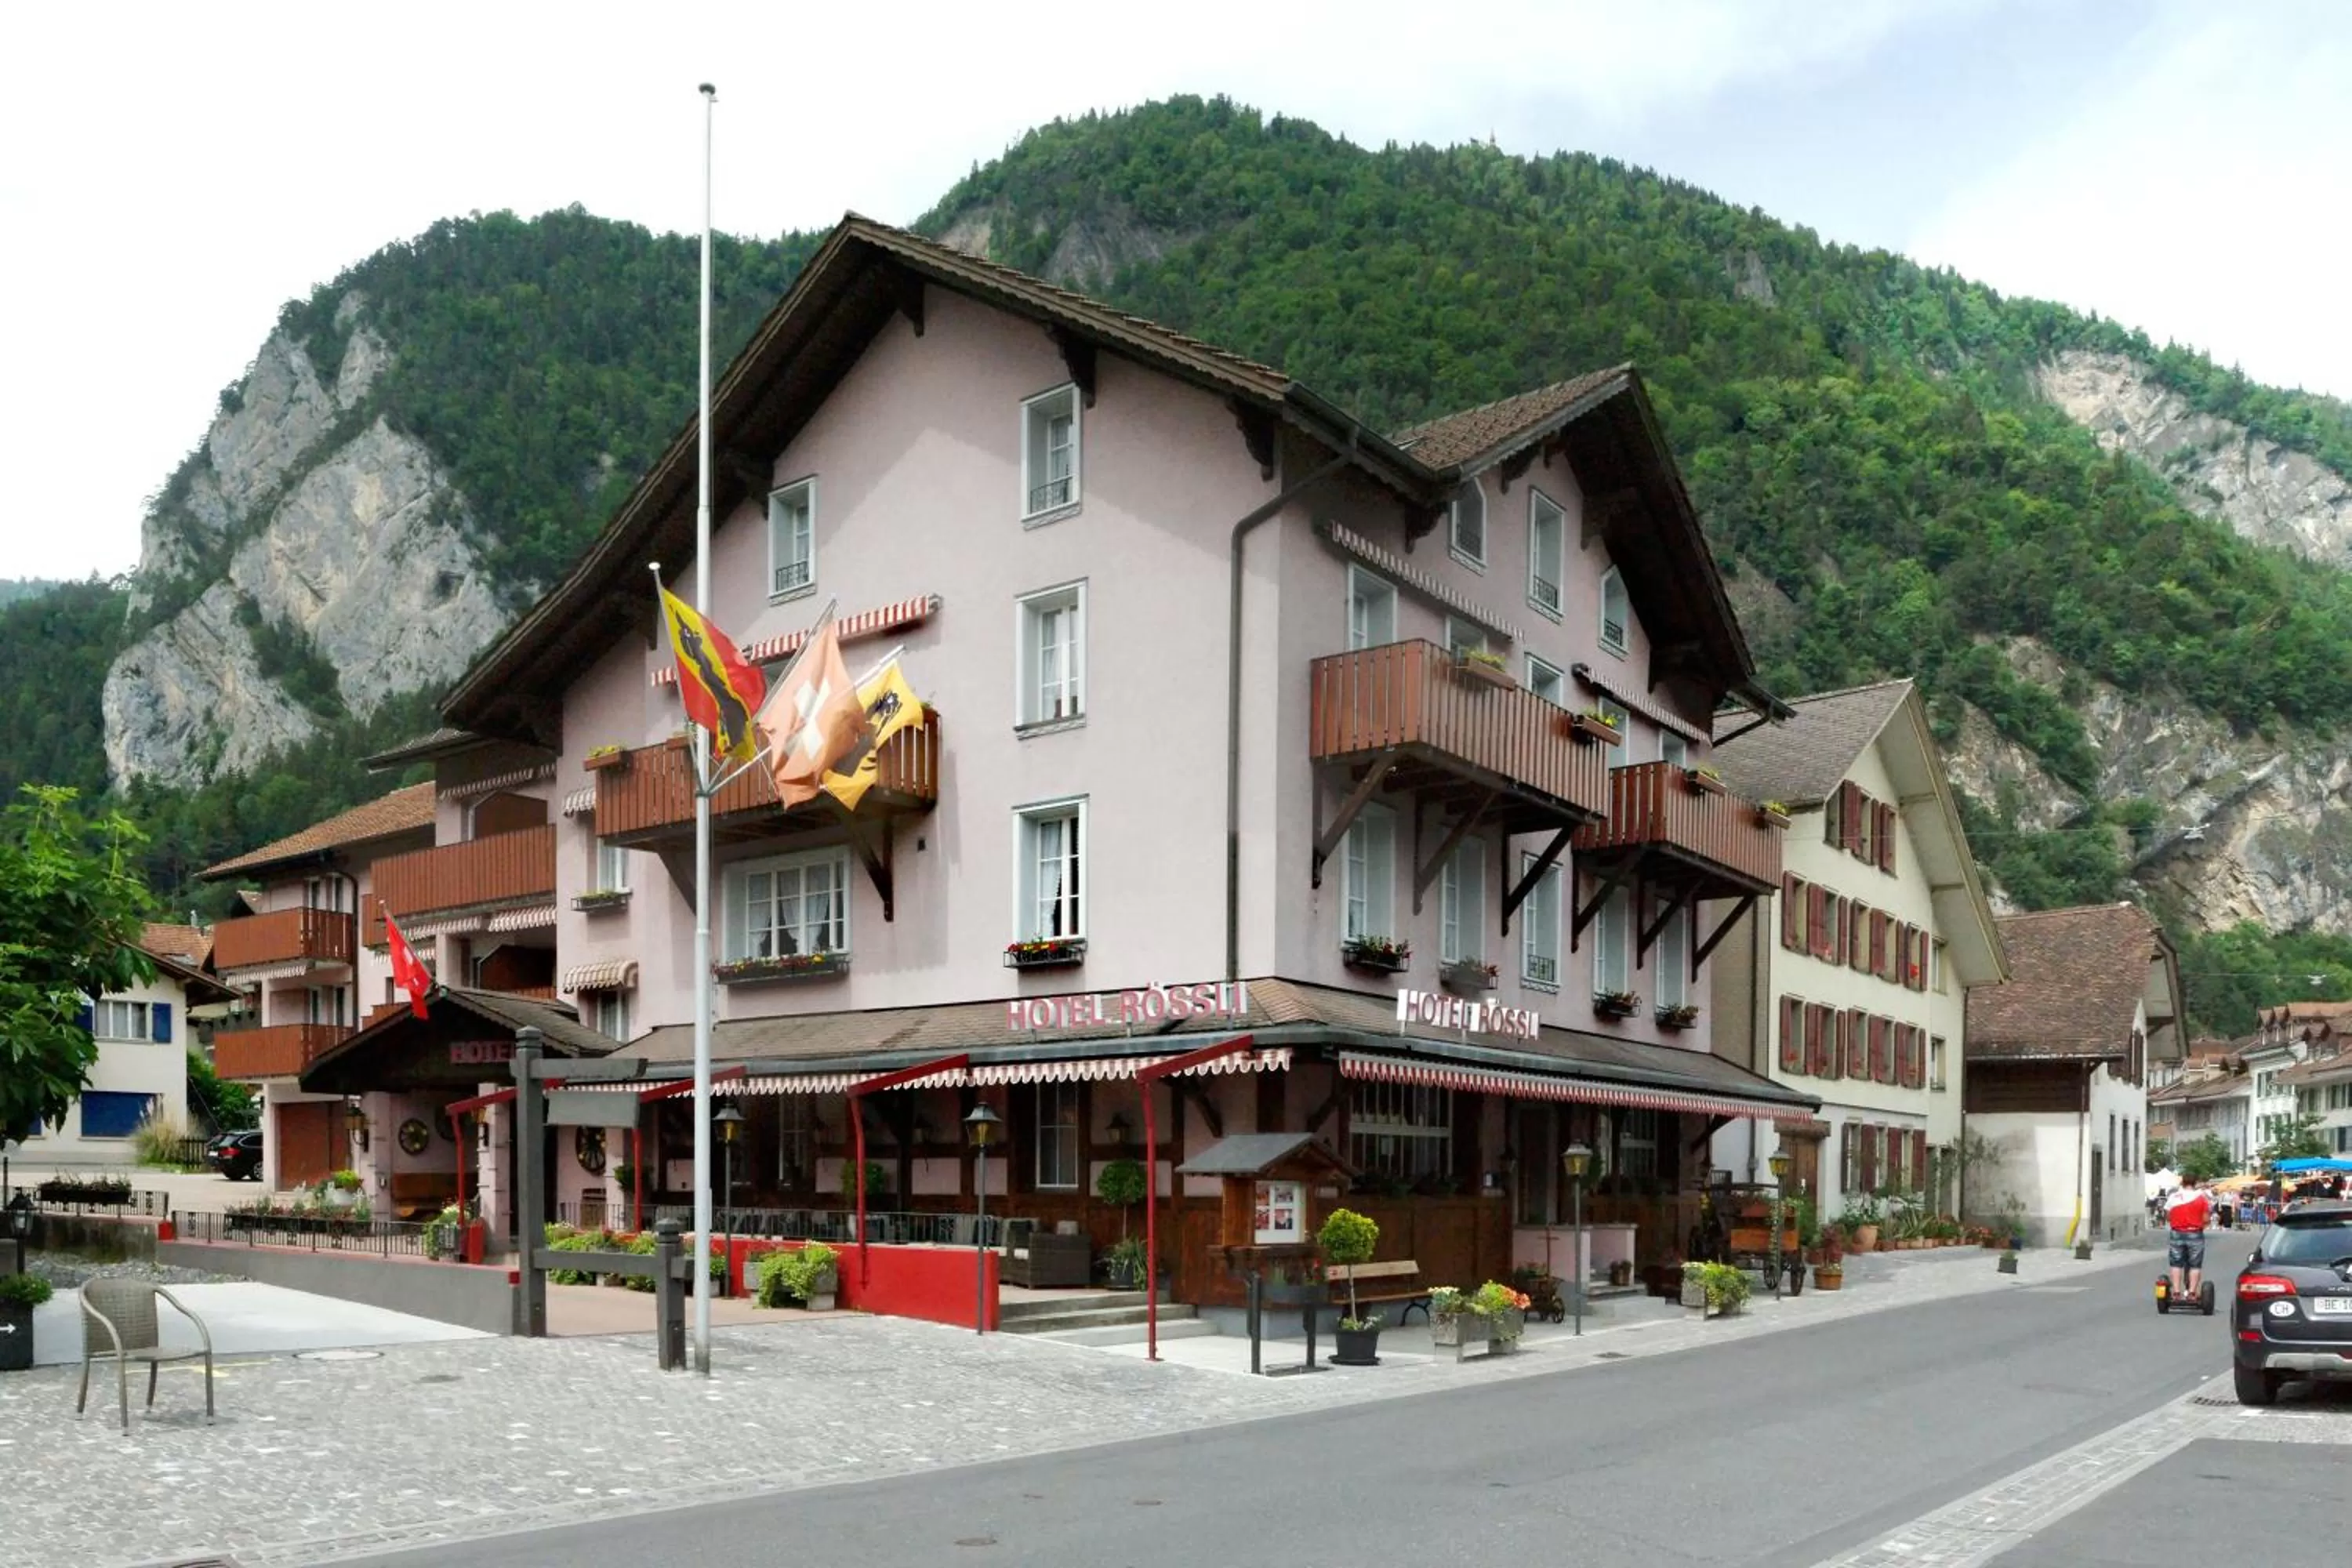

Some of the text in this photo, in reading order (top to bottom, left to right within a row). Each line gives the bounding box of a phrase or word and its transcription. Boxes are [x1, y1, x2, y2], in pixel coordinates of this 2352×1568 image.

[1007, 981, 1245, 1029] HOTEL RÖSSLI
[1399, 989, 1472, 1029] HOTEL
[2274, 1304, 2288, 1315] CH
